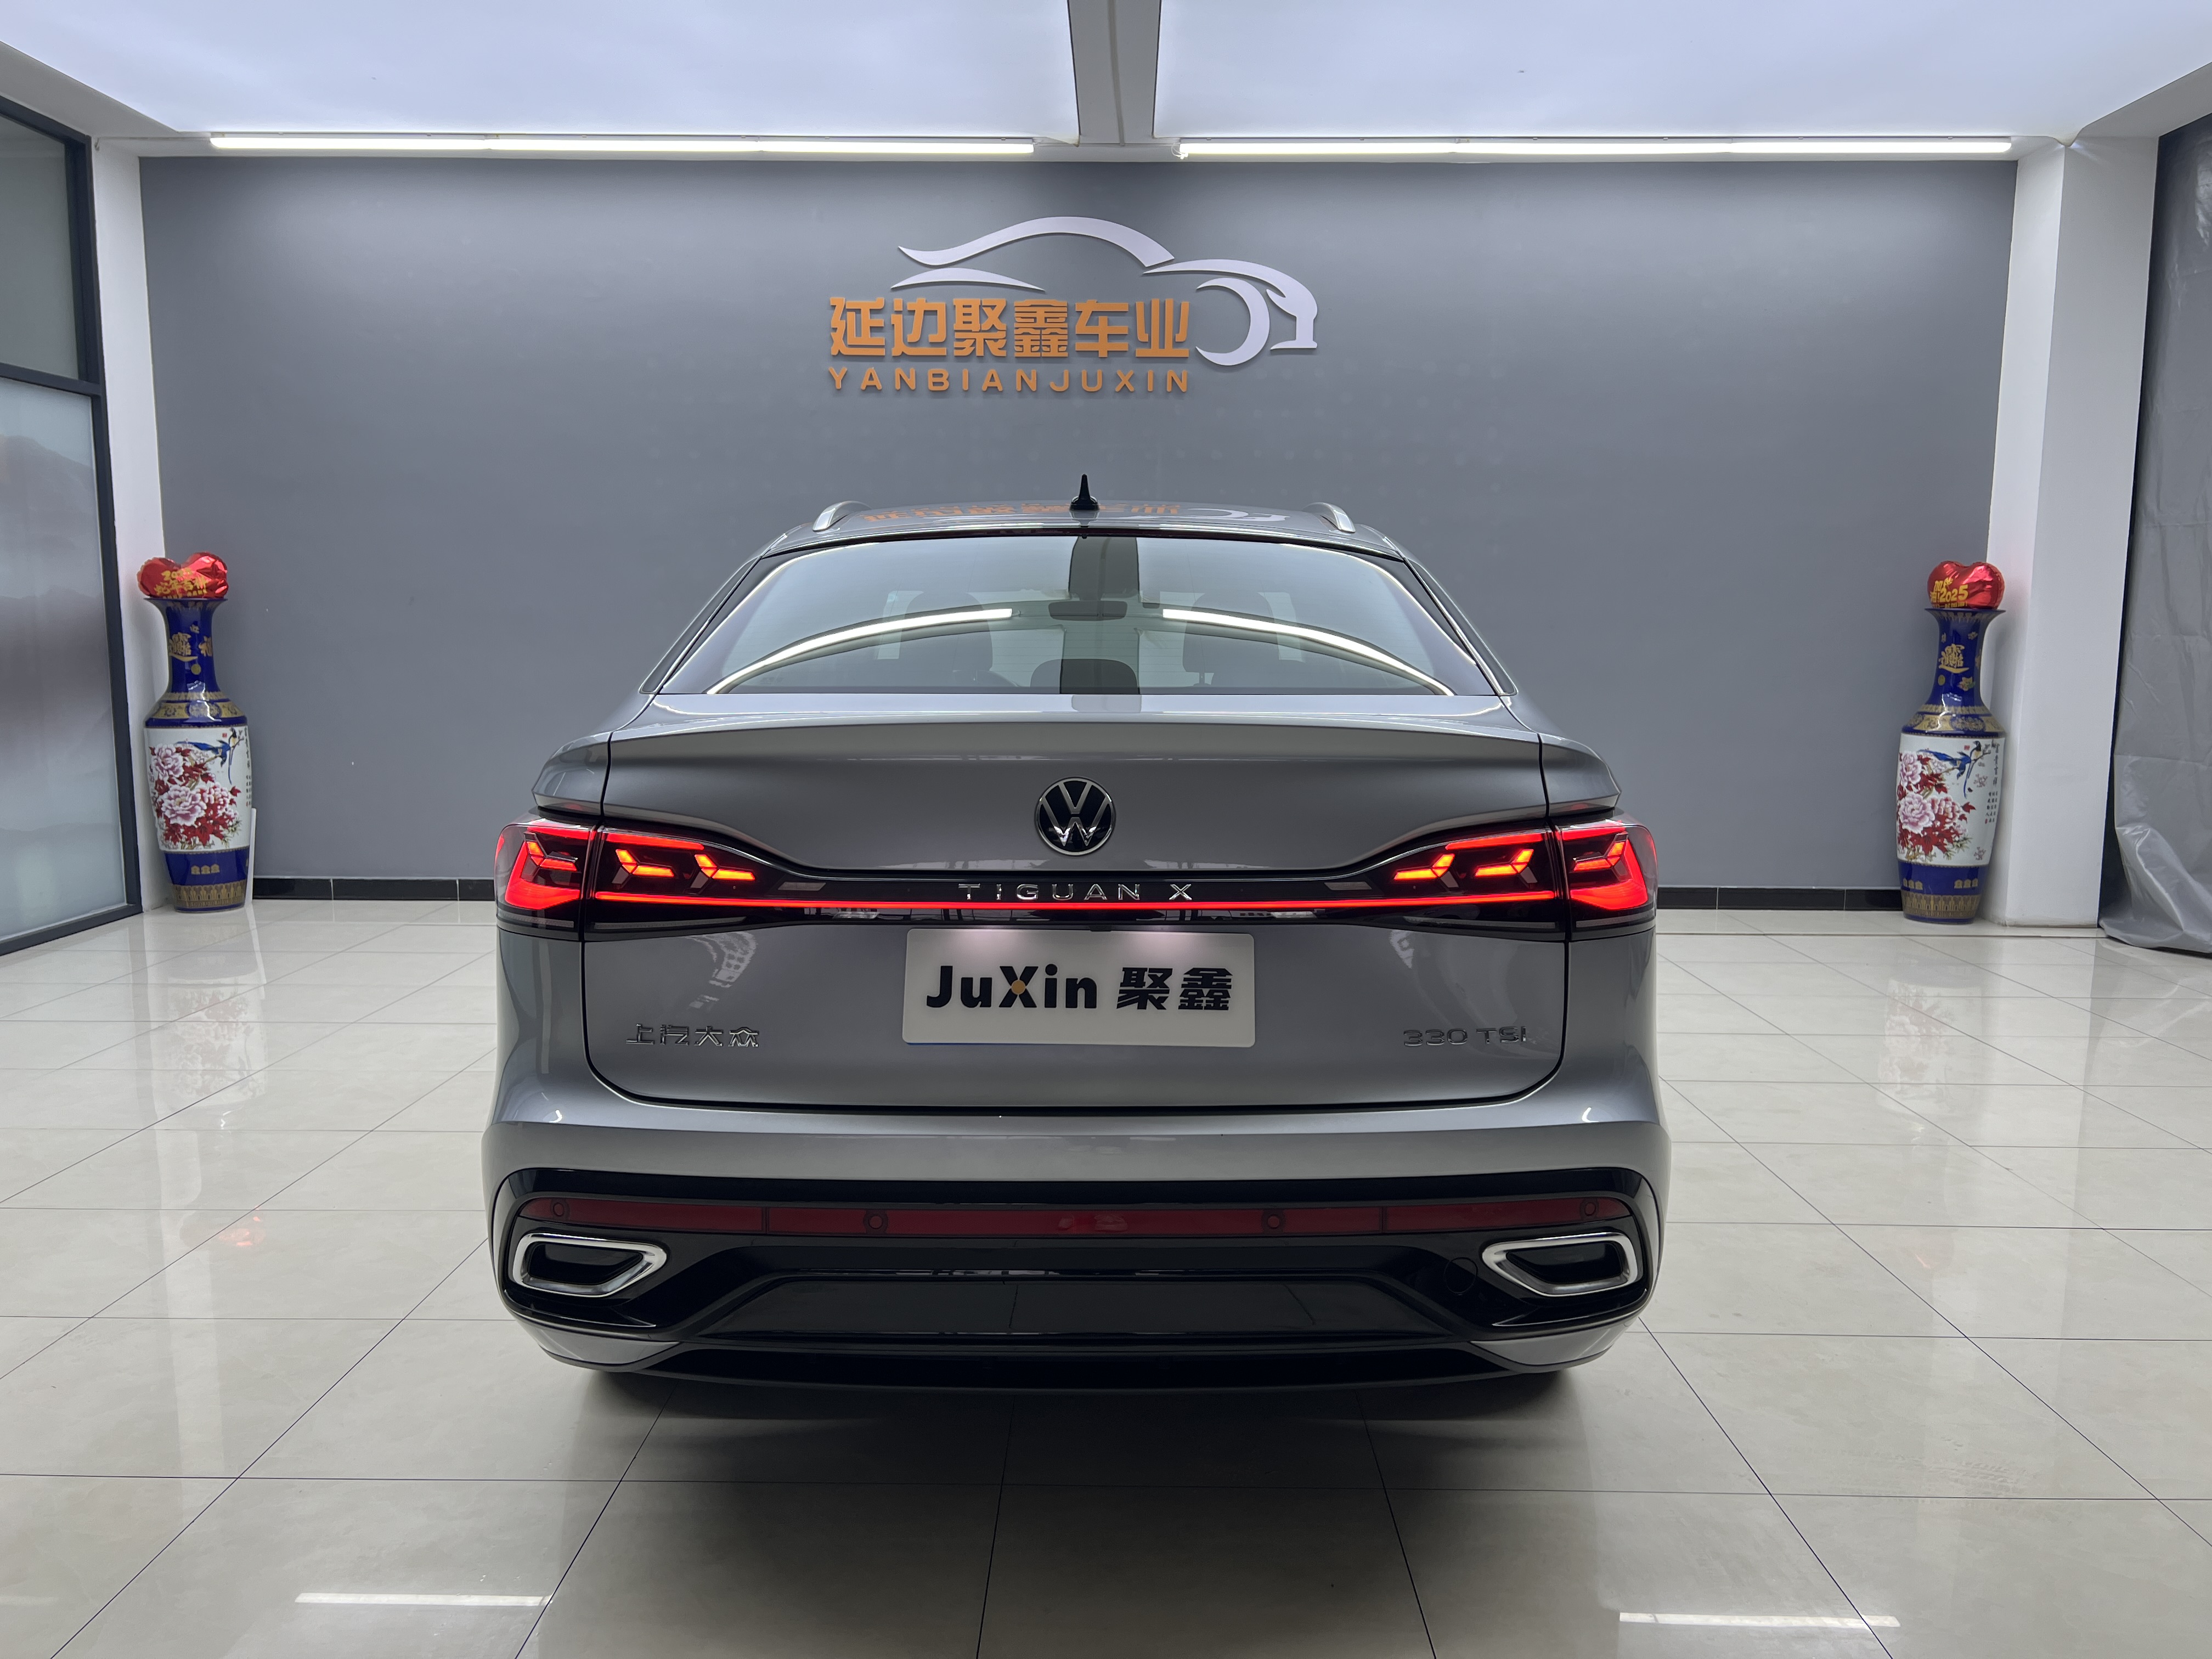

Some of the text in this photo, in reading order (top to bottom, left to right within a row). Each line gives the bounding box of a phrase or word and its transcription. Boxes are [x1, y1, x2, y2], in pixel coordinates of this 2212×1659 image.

[830, 297, 1189, 358] 延边聚鑫车业
[828, 367, 1188, 392] YANBIANJUXIN
[1939, 584, 1968, 603] 2025
[958, 883, 1193, 901] TIGUAN X
[926, 963, 1233, 1011] JuXin 聚鑫
[625, 1023, 759, 1047] 上汽大众
[1403, 1026, 1527, 1046] 330 TSI
